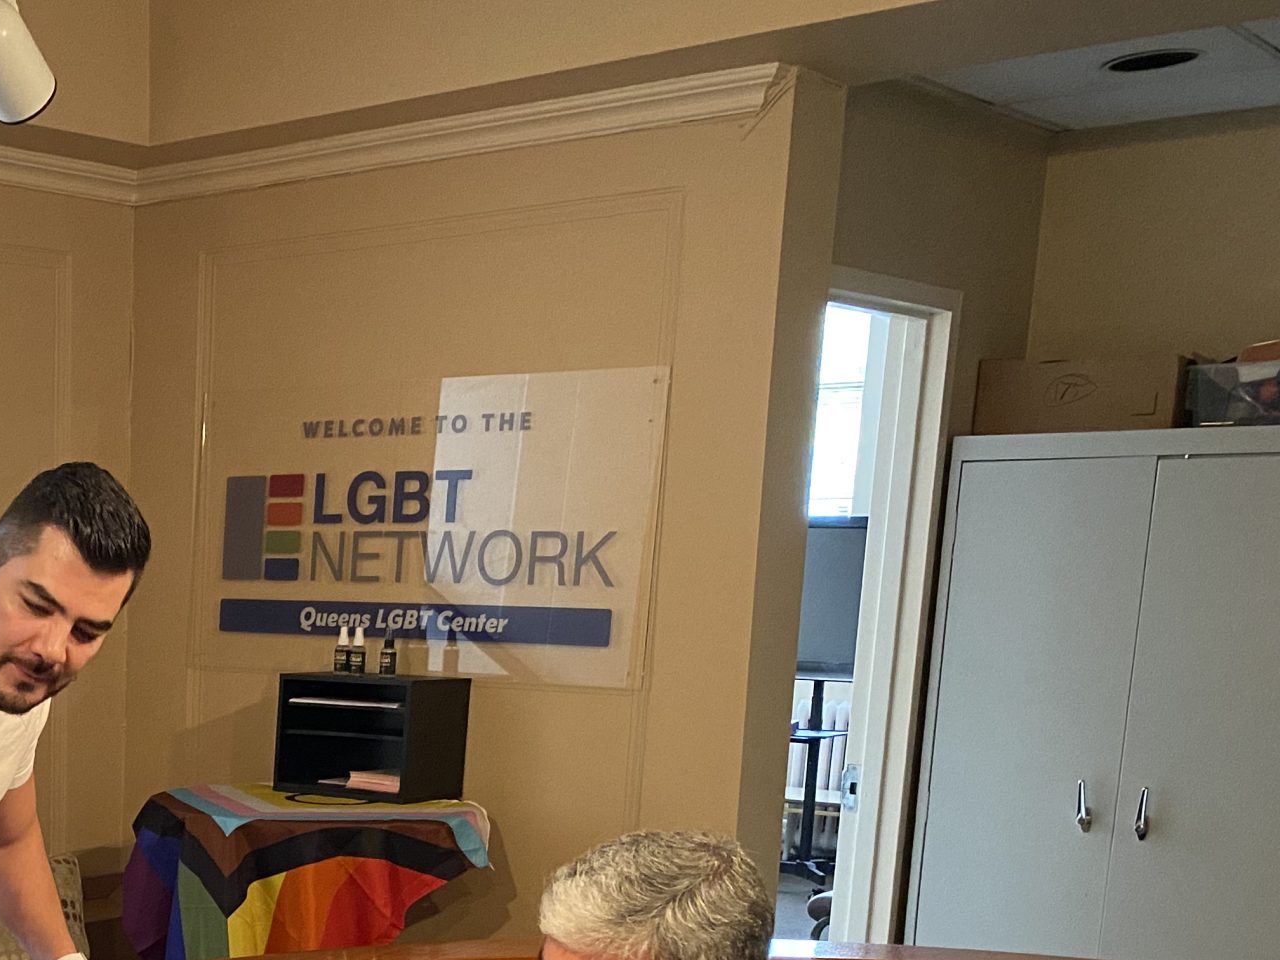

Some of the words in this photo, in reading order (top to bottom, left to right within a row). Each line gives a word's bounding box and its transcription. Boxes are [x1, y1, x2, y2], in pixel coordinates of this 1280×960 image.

[303, 415, 422, 439] WELCOME
[436, 414, 468, 435] TO
[482, 411, 533, 433] THE
[313, 469, 473, 525] LGBT
[310, 530, 617, 588] NETWORK
[299, 606, 371, 630] Queens
[375, 608, 432, 629] LGBT
[436, 610, 509, 634] Center
